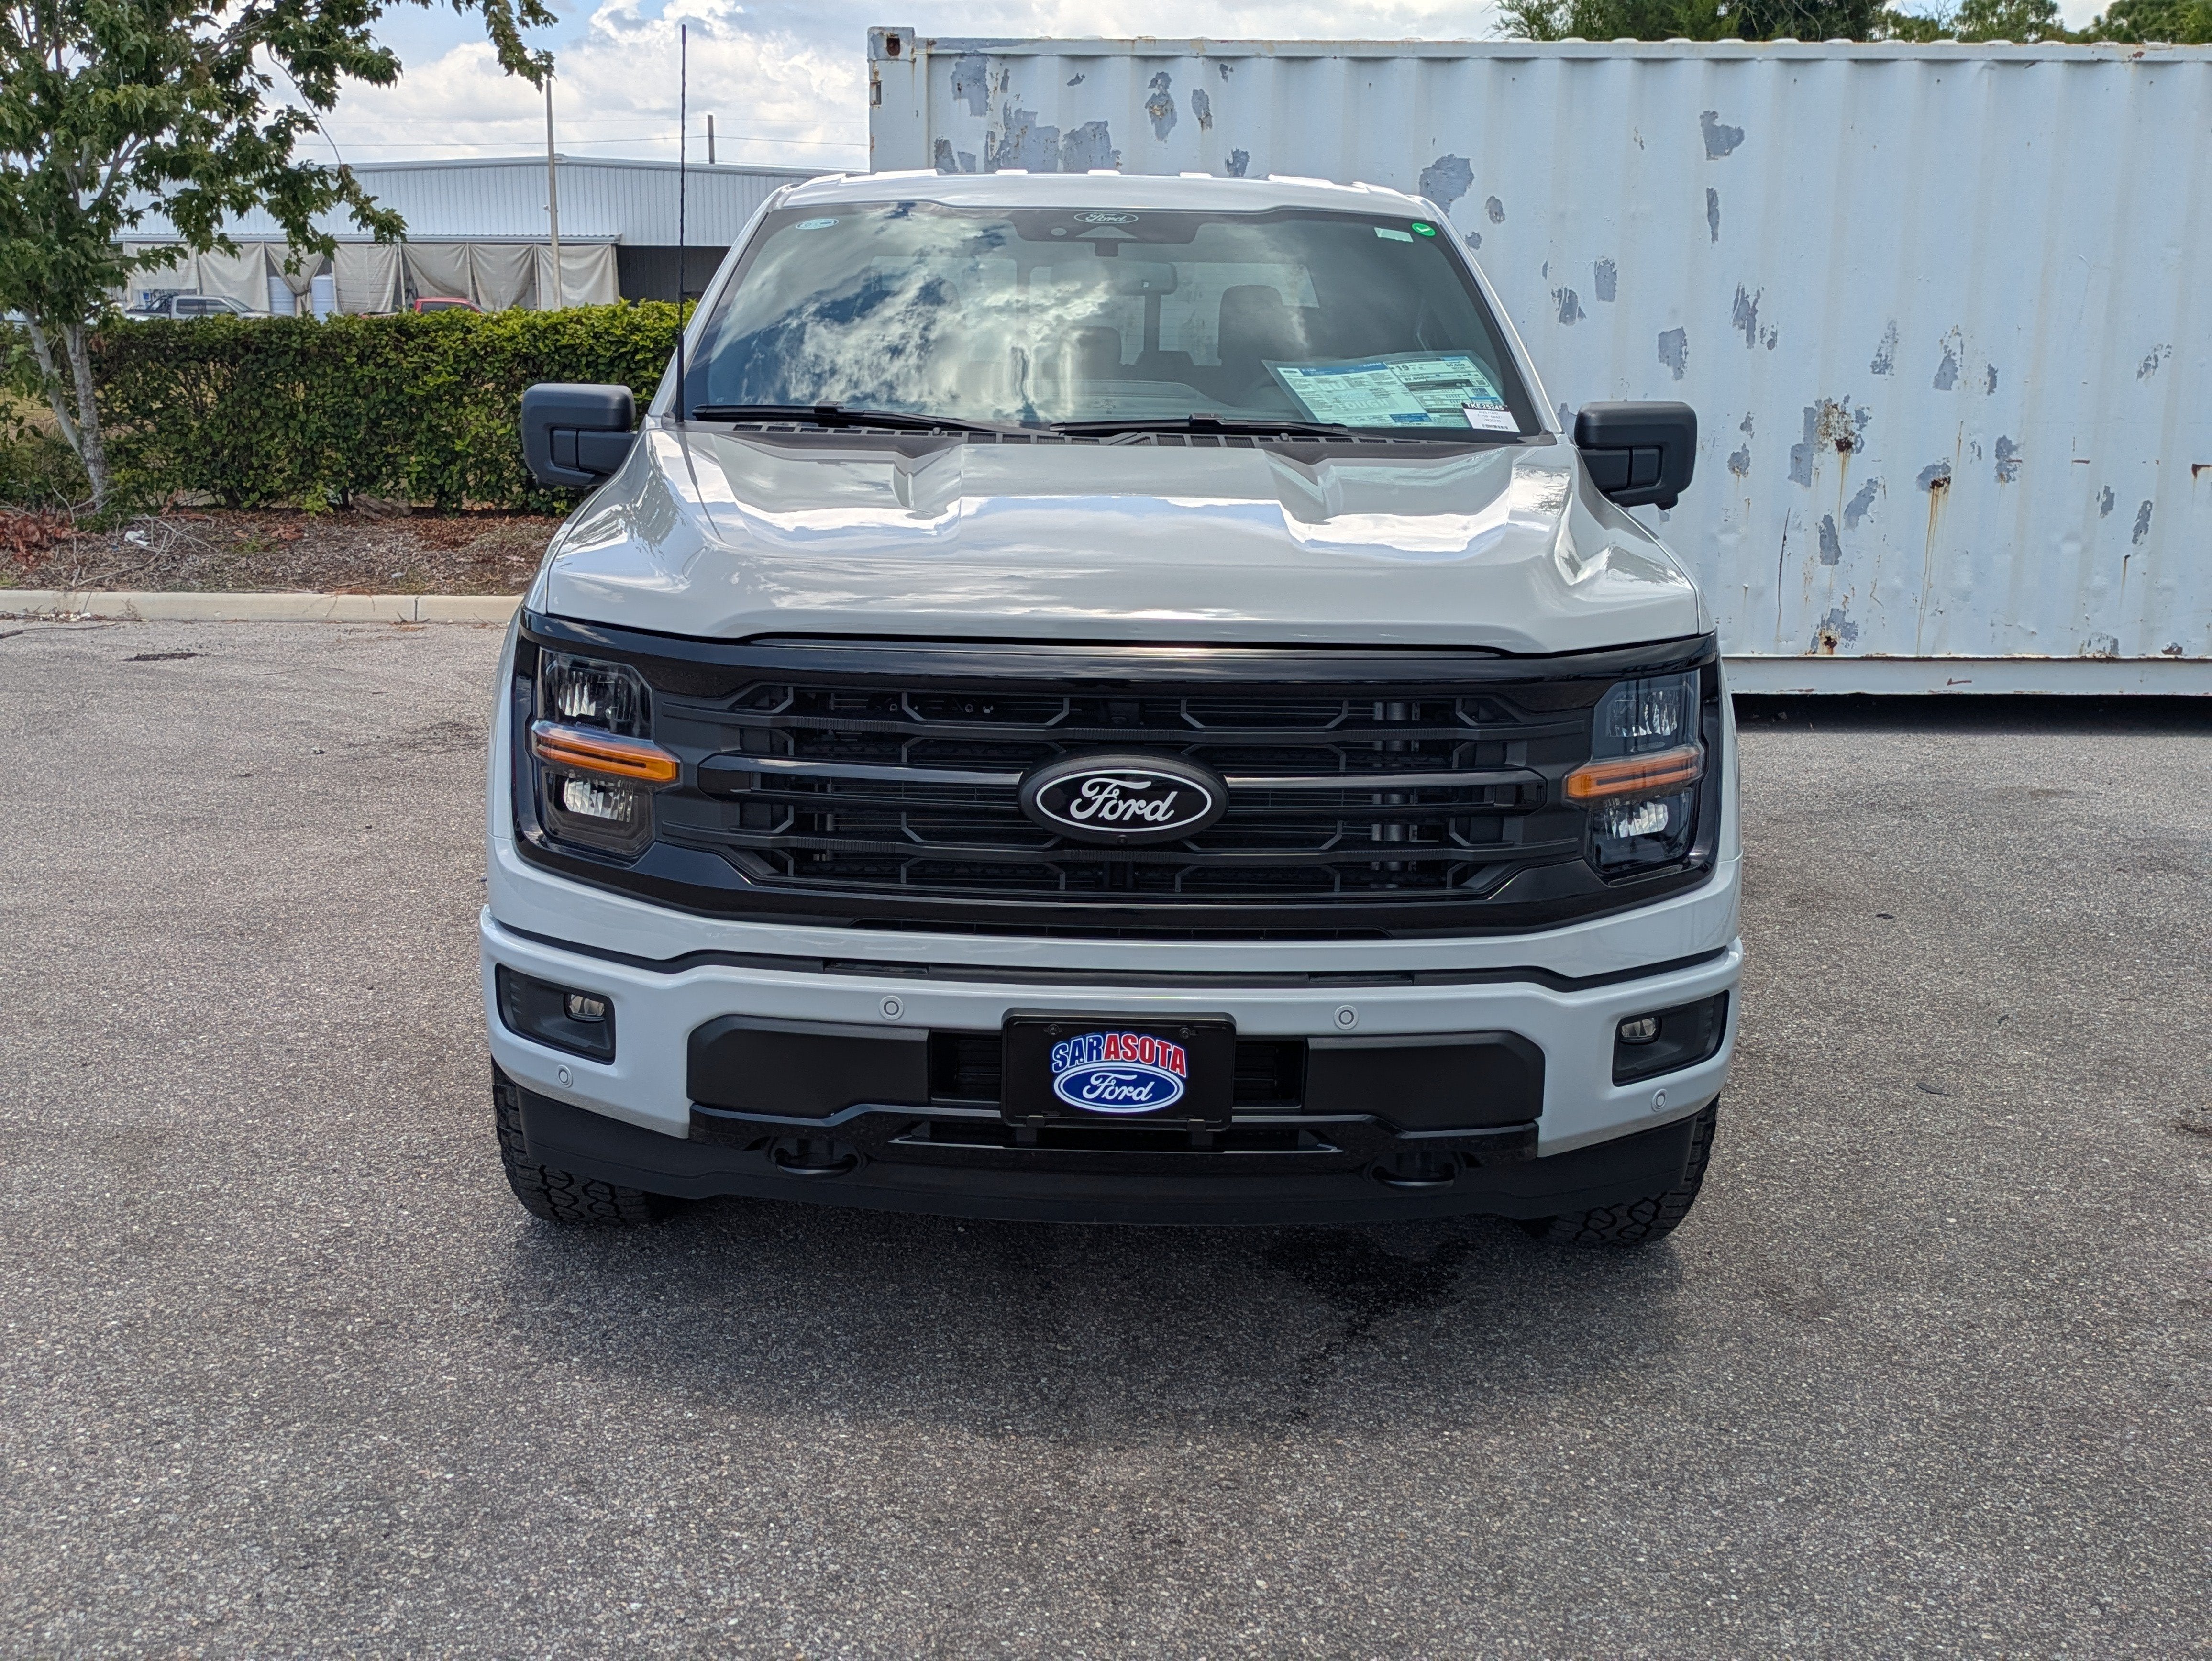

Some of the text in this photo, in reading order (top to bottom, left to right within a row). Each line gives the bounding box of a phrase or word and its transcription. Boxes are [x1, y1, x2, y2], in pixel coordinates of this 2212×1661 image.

[1085, 213, 1127, 222] Ford
[1070, 778, 1178, 822] Ford
[1051, 1033, 1187, 1078] SARASOTA
[1083, 1072, 1155, 1101] Ford
